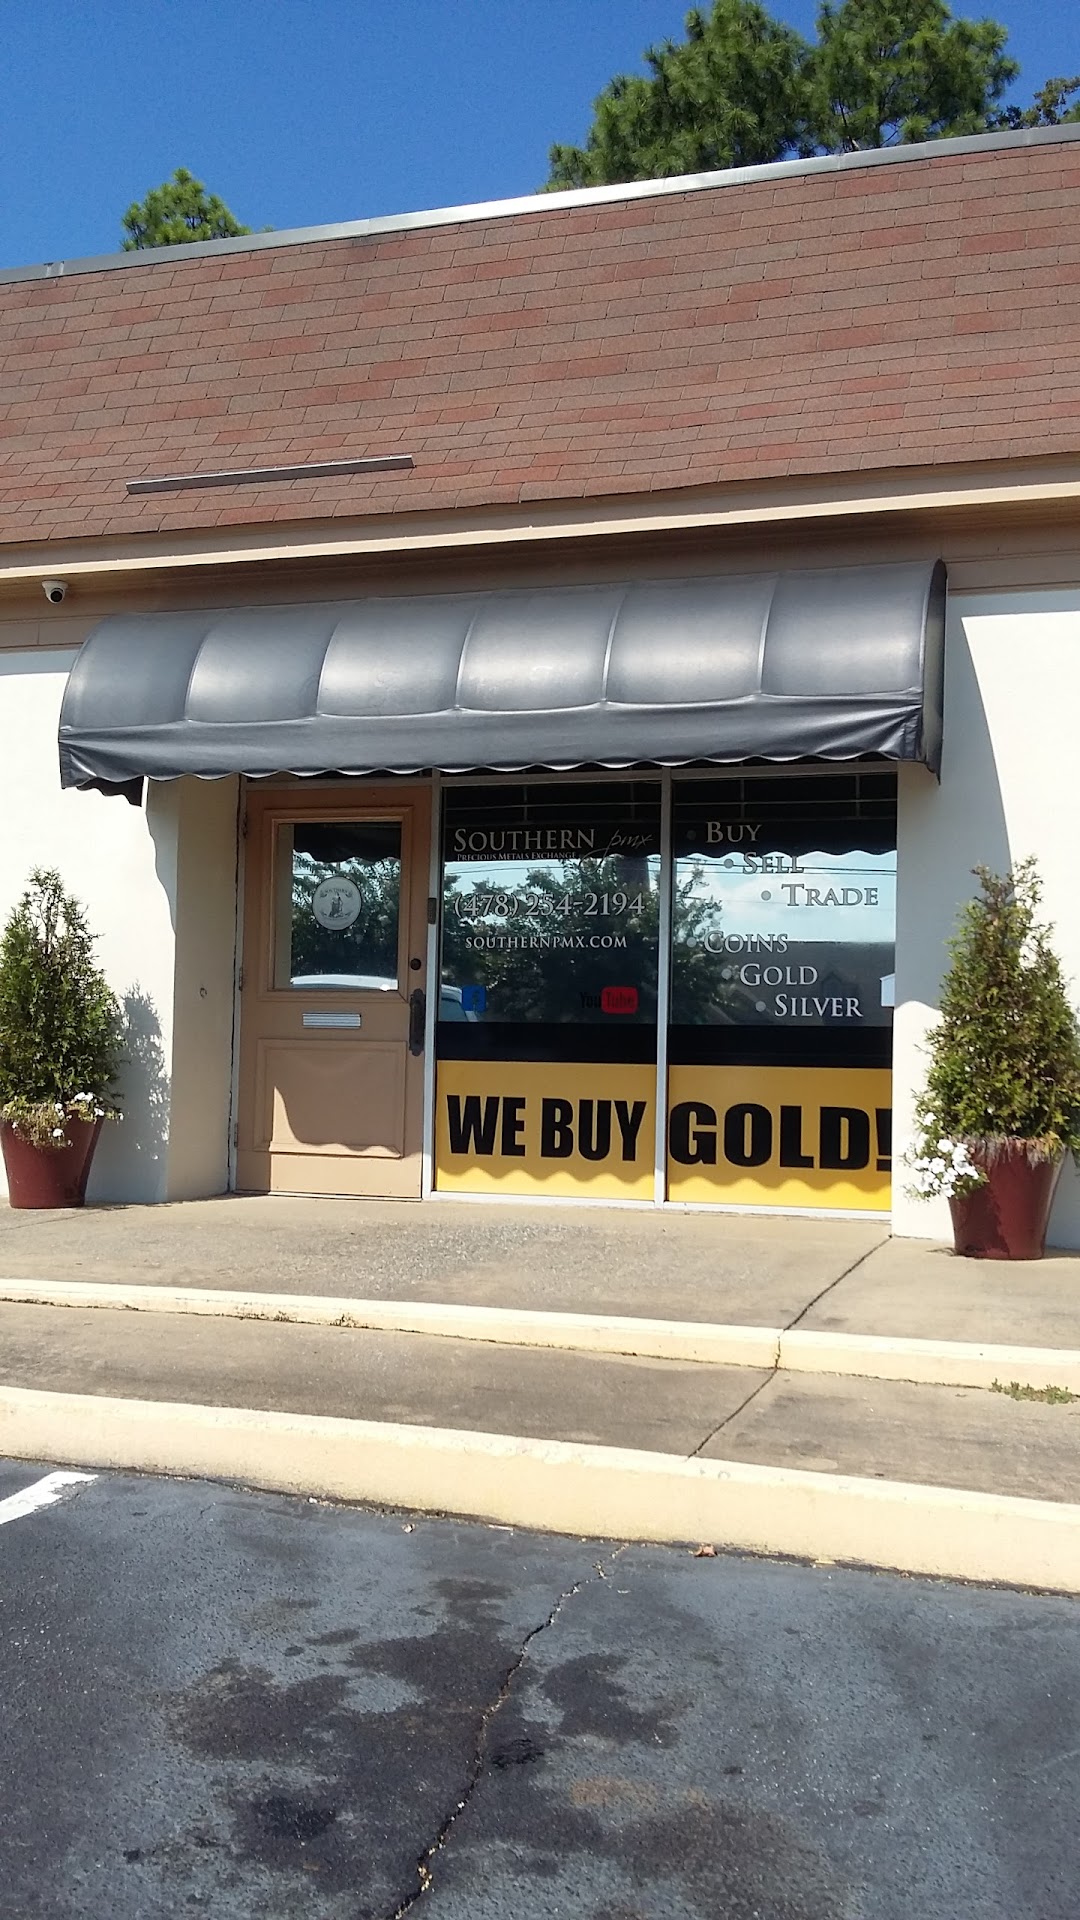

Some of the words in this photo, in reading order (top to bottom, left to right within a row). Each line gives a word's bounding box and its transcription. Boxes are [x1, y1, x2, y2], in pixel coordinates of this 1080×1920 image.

[706, 821, 762, 843] BUY
[454, 828, 595, 852] SOUTHERN
[579, 829, 653, 875] pmx
[457, 853, 497, 862] PRECIOUS
[499, 852, 528, 861] METALS
[531, 851, 576, 860] EXCHANGE
[742, 852, 804, 874] SELL
[454, 893, 520, 918] (478)
[525, 892, 645, 917] 254-2194
[781, 883, 879, 906] TRADE
[465, 935, 627, 950] SOUTHERNPMX.COM
[703, 930, 788, 953] COINS
[740, 963, 818, 986] GOLD
[774, 994, 863, 1017] SILVER
[446, 1095, 525, 1156] WE
[541, 1098, 647, 1162] BUY
[669, 1101, 892, 1171] GOLD!
